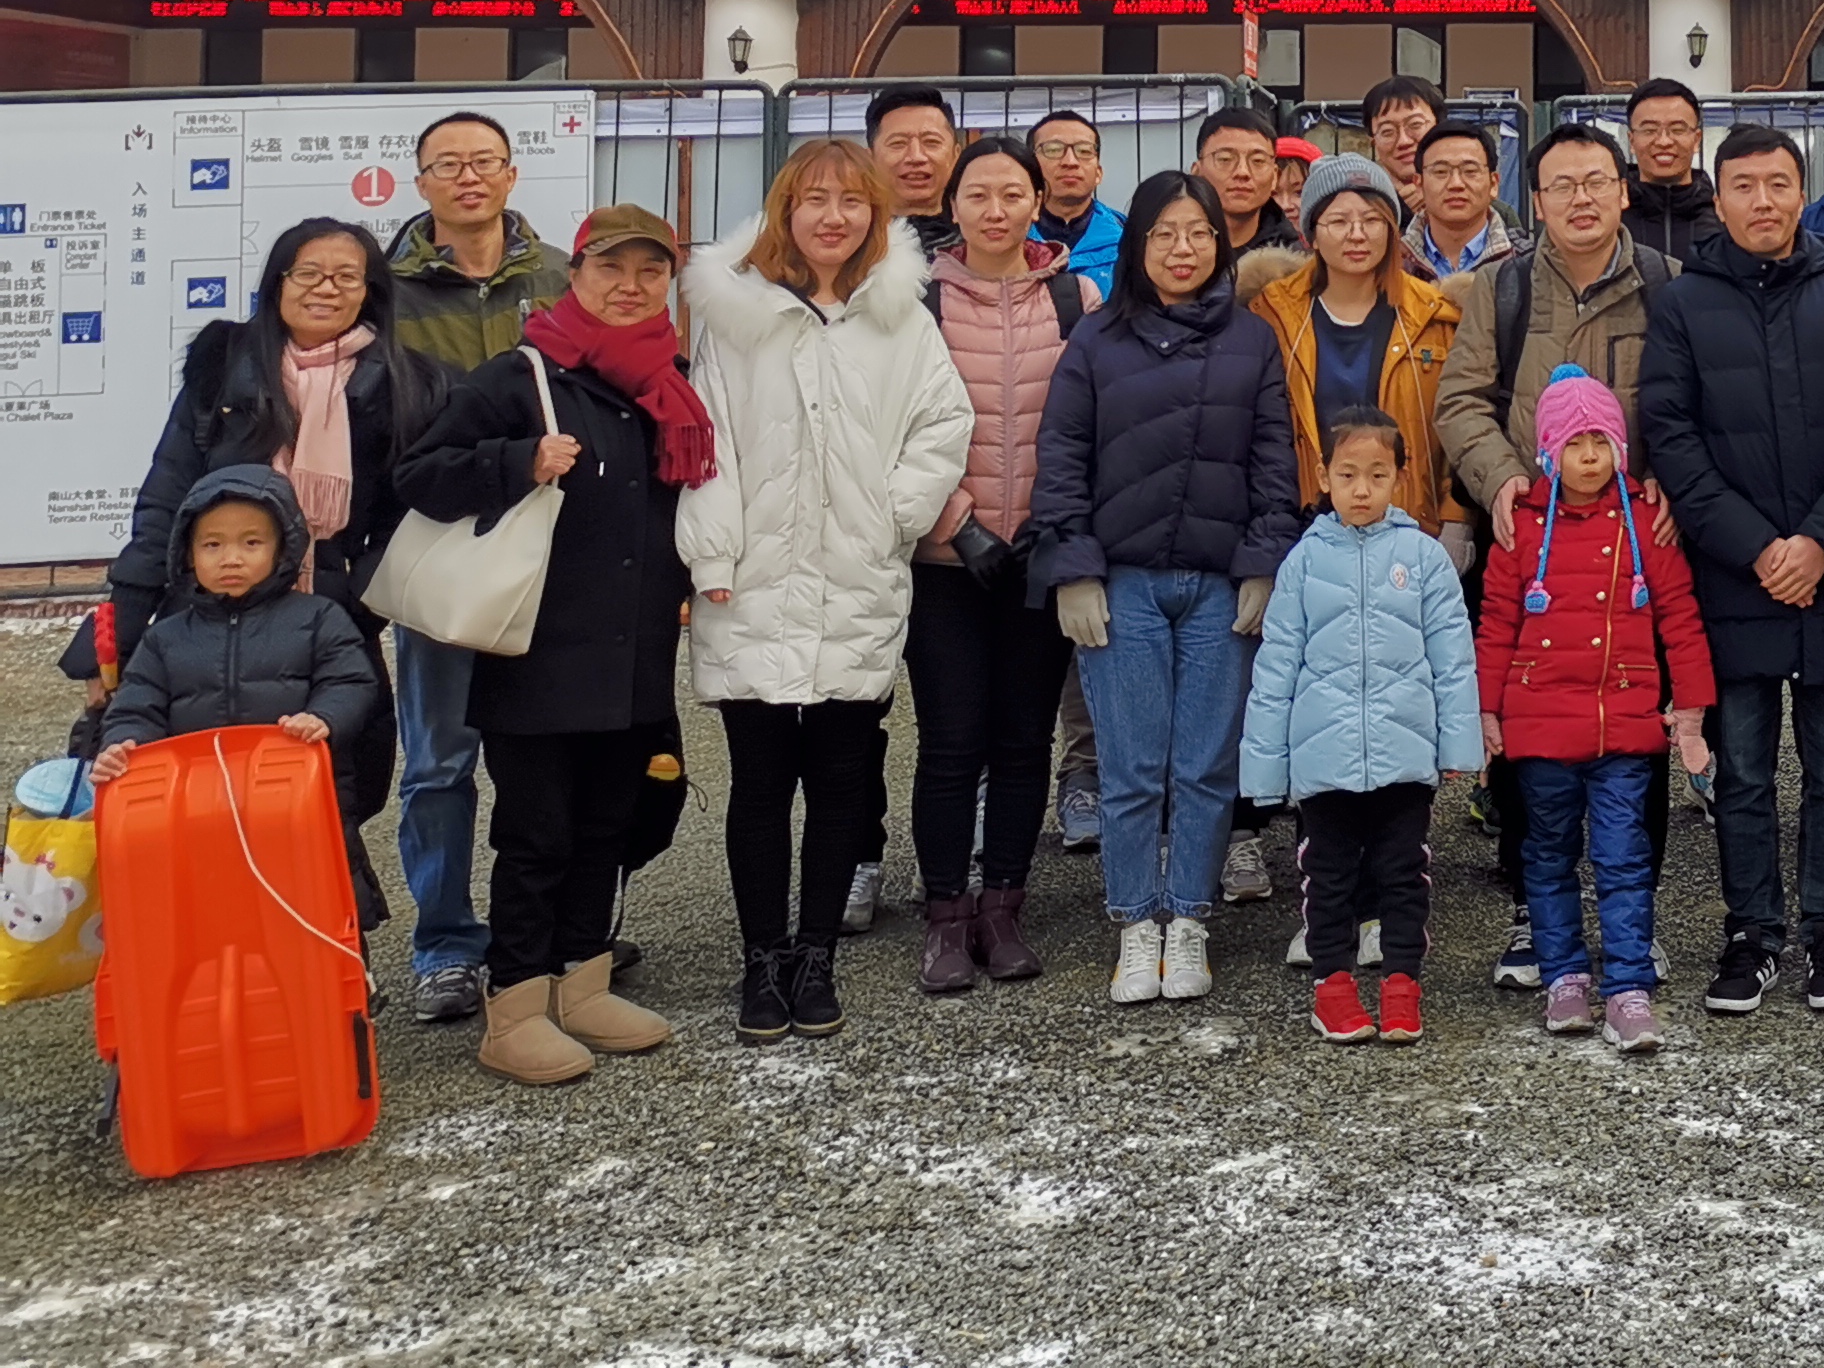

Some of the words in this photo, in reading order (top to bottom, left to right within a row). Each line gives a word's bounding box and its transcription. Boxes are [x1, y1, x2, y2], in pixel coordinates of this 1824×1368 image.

[180, 125, 238, 135] Information
[250, 137, 283, 153] 头盔
[246, 154, 283, 163] Helmet
[291, 152, 334, 164] Goggles
[342, 151, 363, 161] Suit
[526, 145, 556, 156] Boots
[361, 166, 386, 202] 1
[30, 222, 75, 233] Entrance
[78, 221, 107, 231] Ticket
[130, 181, 148, 286] 入场主通道
[44, 411, 74, 421] Plaza
[47, 503, 95, 513] Nanshan
[47, 514, 88, 524] Terrace
